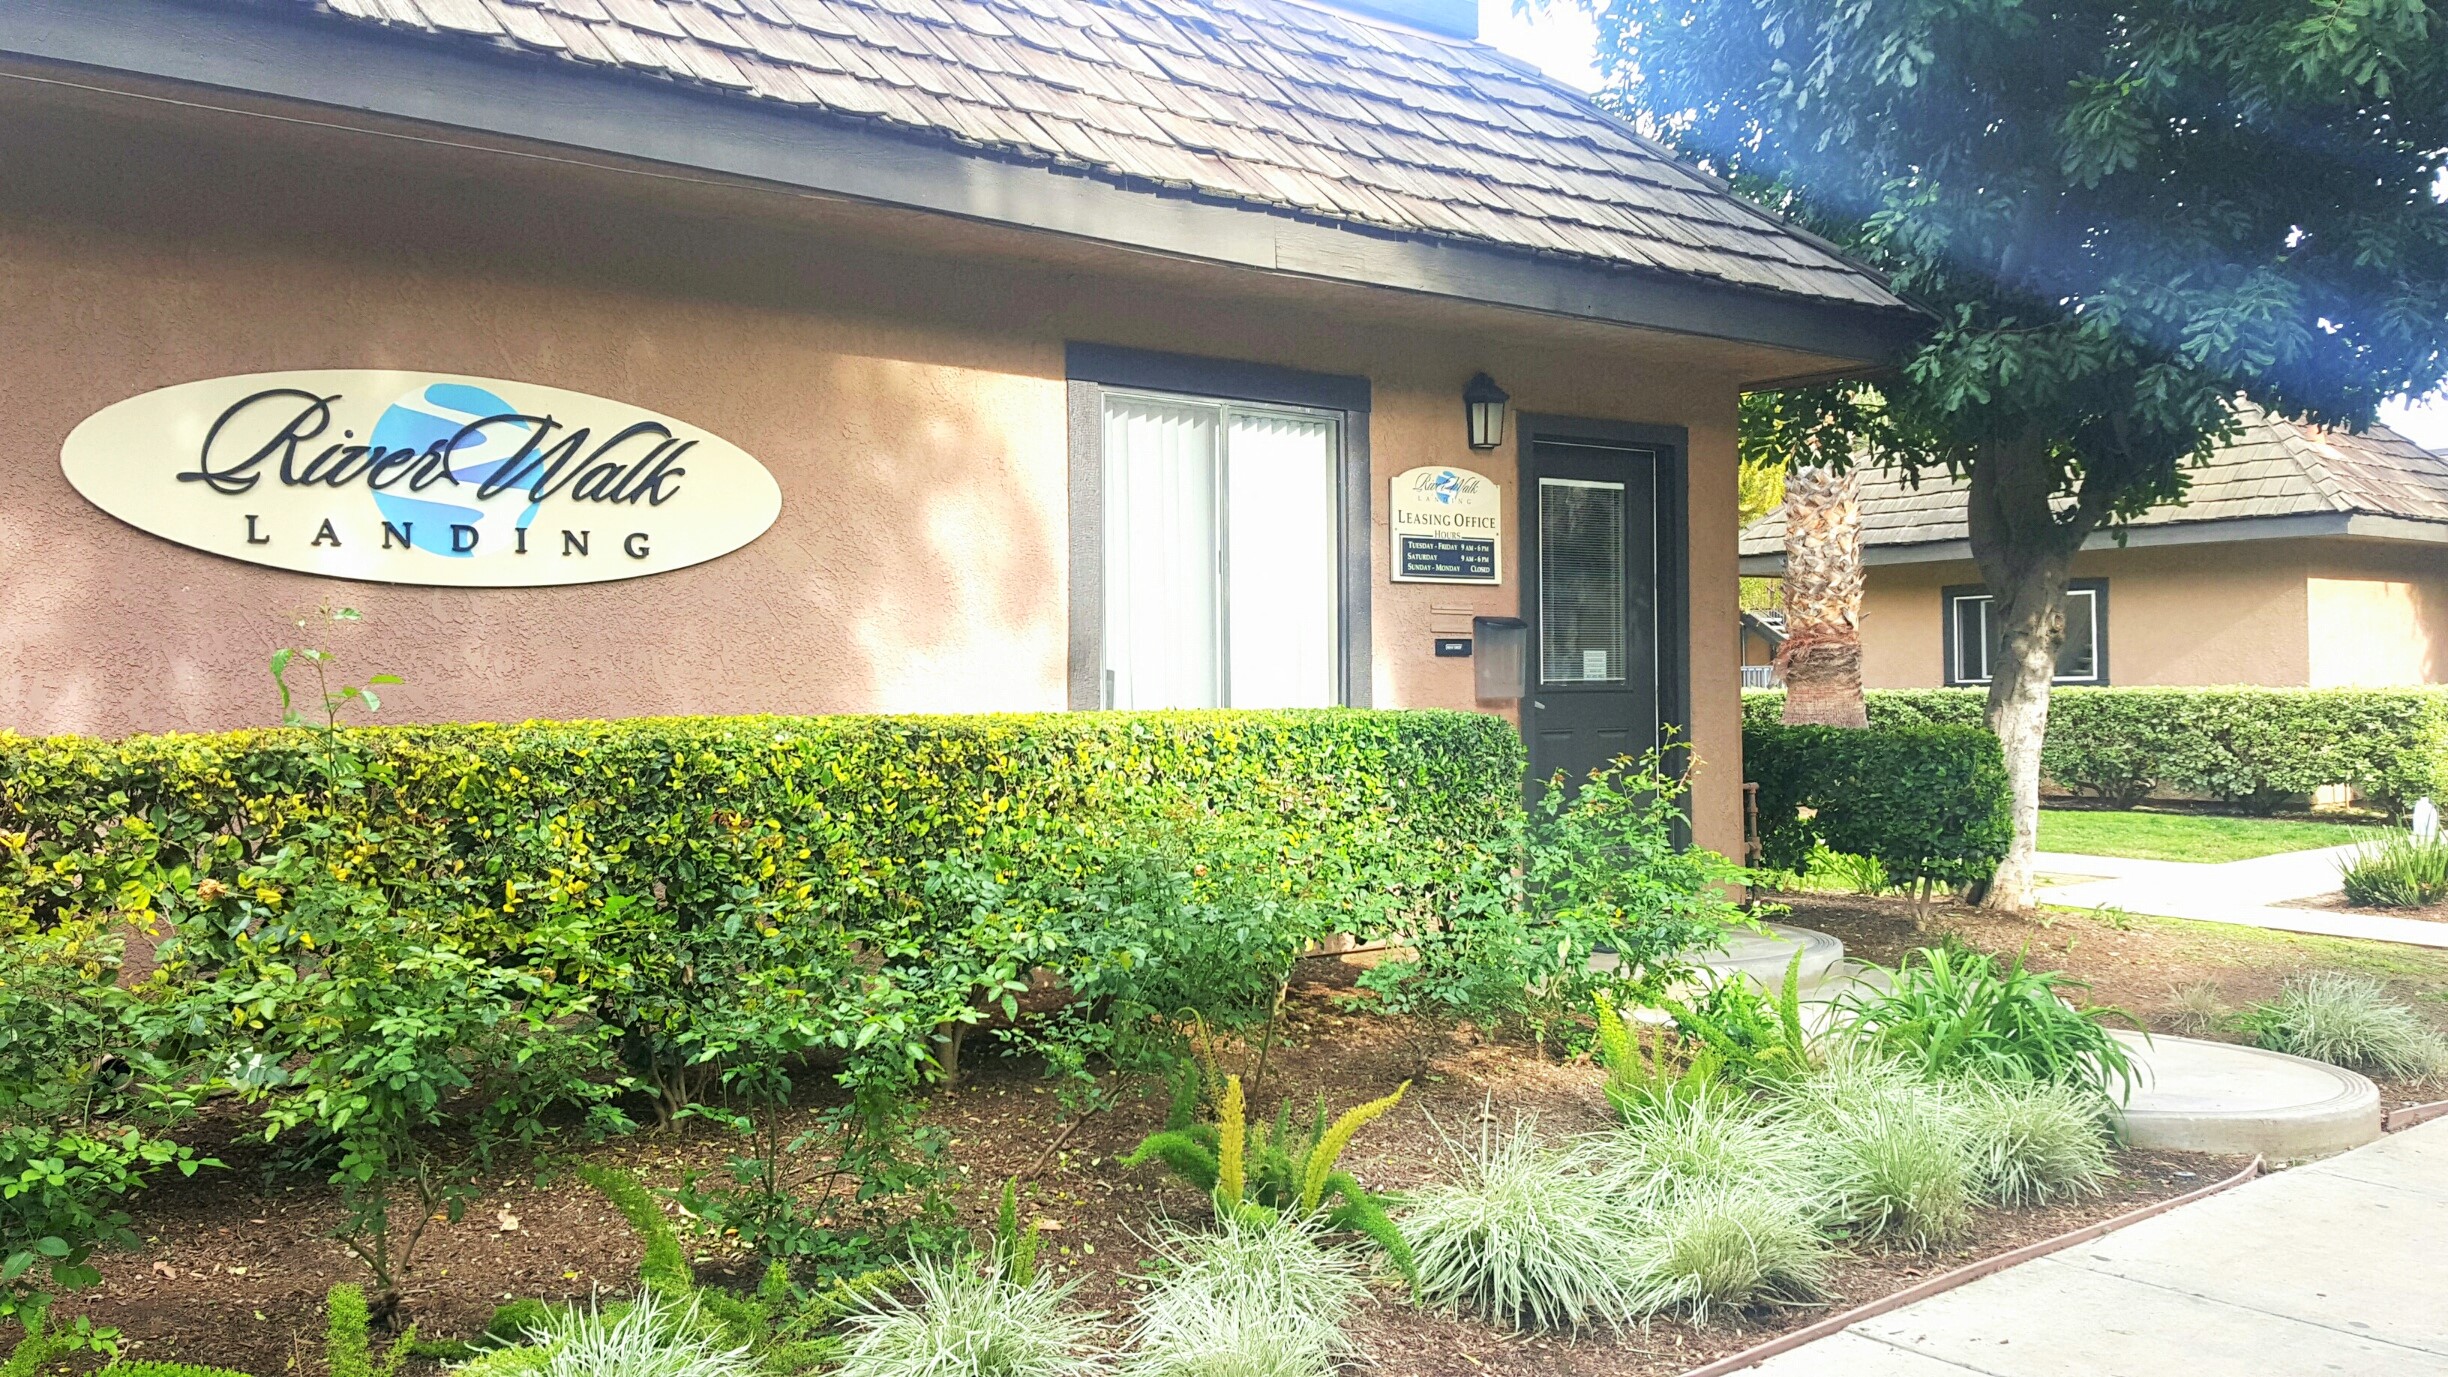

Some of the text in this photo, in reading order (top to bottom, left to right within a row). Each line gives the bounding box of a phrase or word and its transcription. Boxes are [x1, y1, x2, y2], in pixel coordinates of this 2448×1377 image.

[176, 388, 701, 507] River Walk
[1444, 476, 1481, 499] Walk
[1417, 495, 1472, 505] LANDING
[1398, 509, 1496, 529] LEASING OFFICE
[244, 513, 652, 560] LANDING
[1434, 530, 1461, 539] HOURS
[1407, 541, 1434, 550] TUESDAY
[1438, 543, 1458, 551] FRIDAY
[1407, 552, 1438, 561] SATURDAY
[1407, 563, 1432, 571] SUNDAY
[1435, 564, 1460, 572] MONDAY
[1470, 565, 1490, 573] CLOSED
